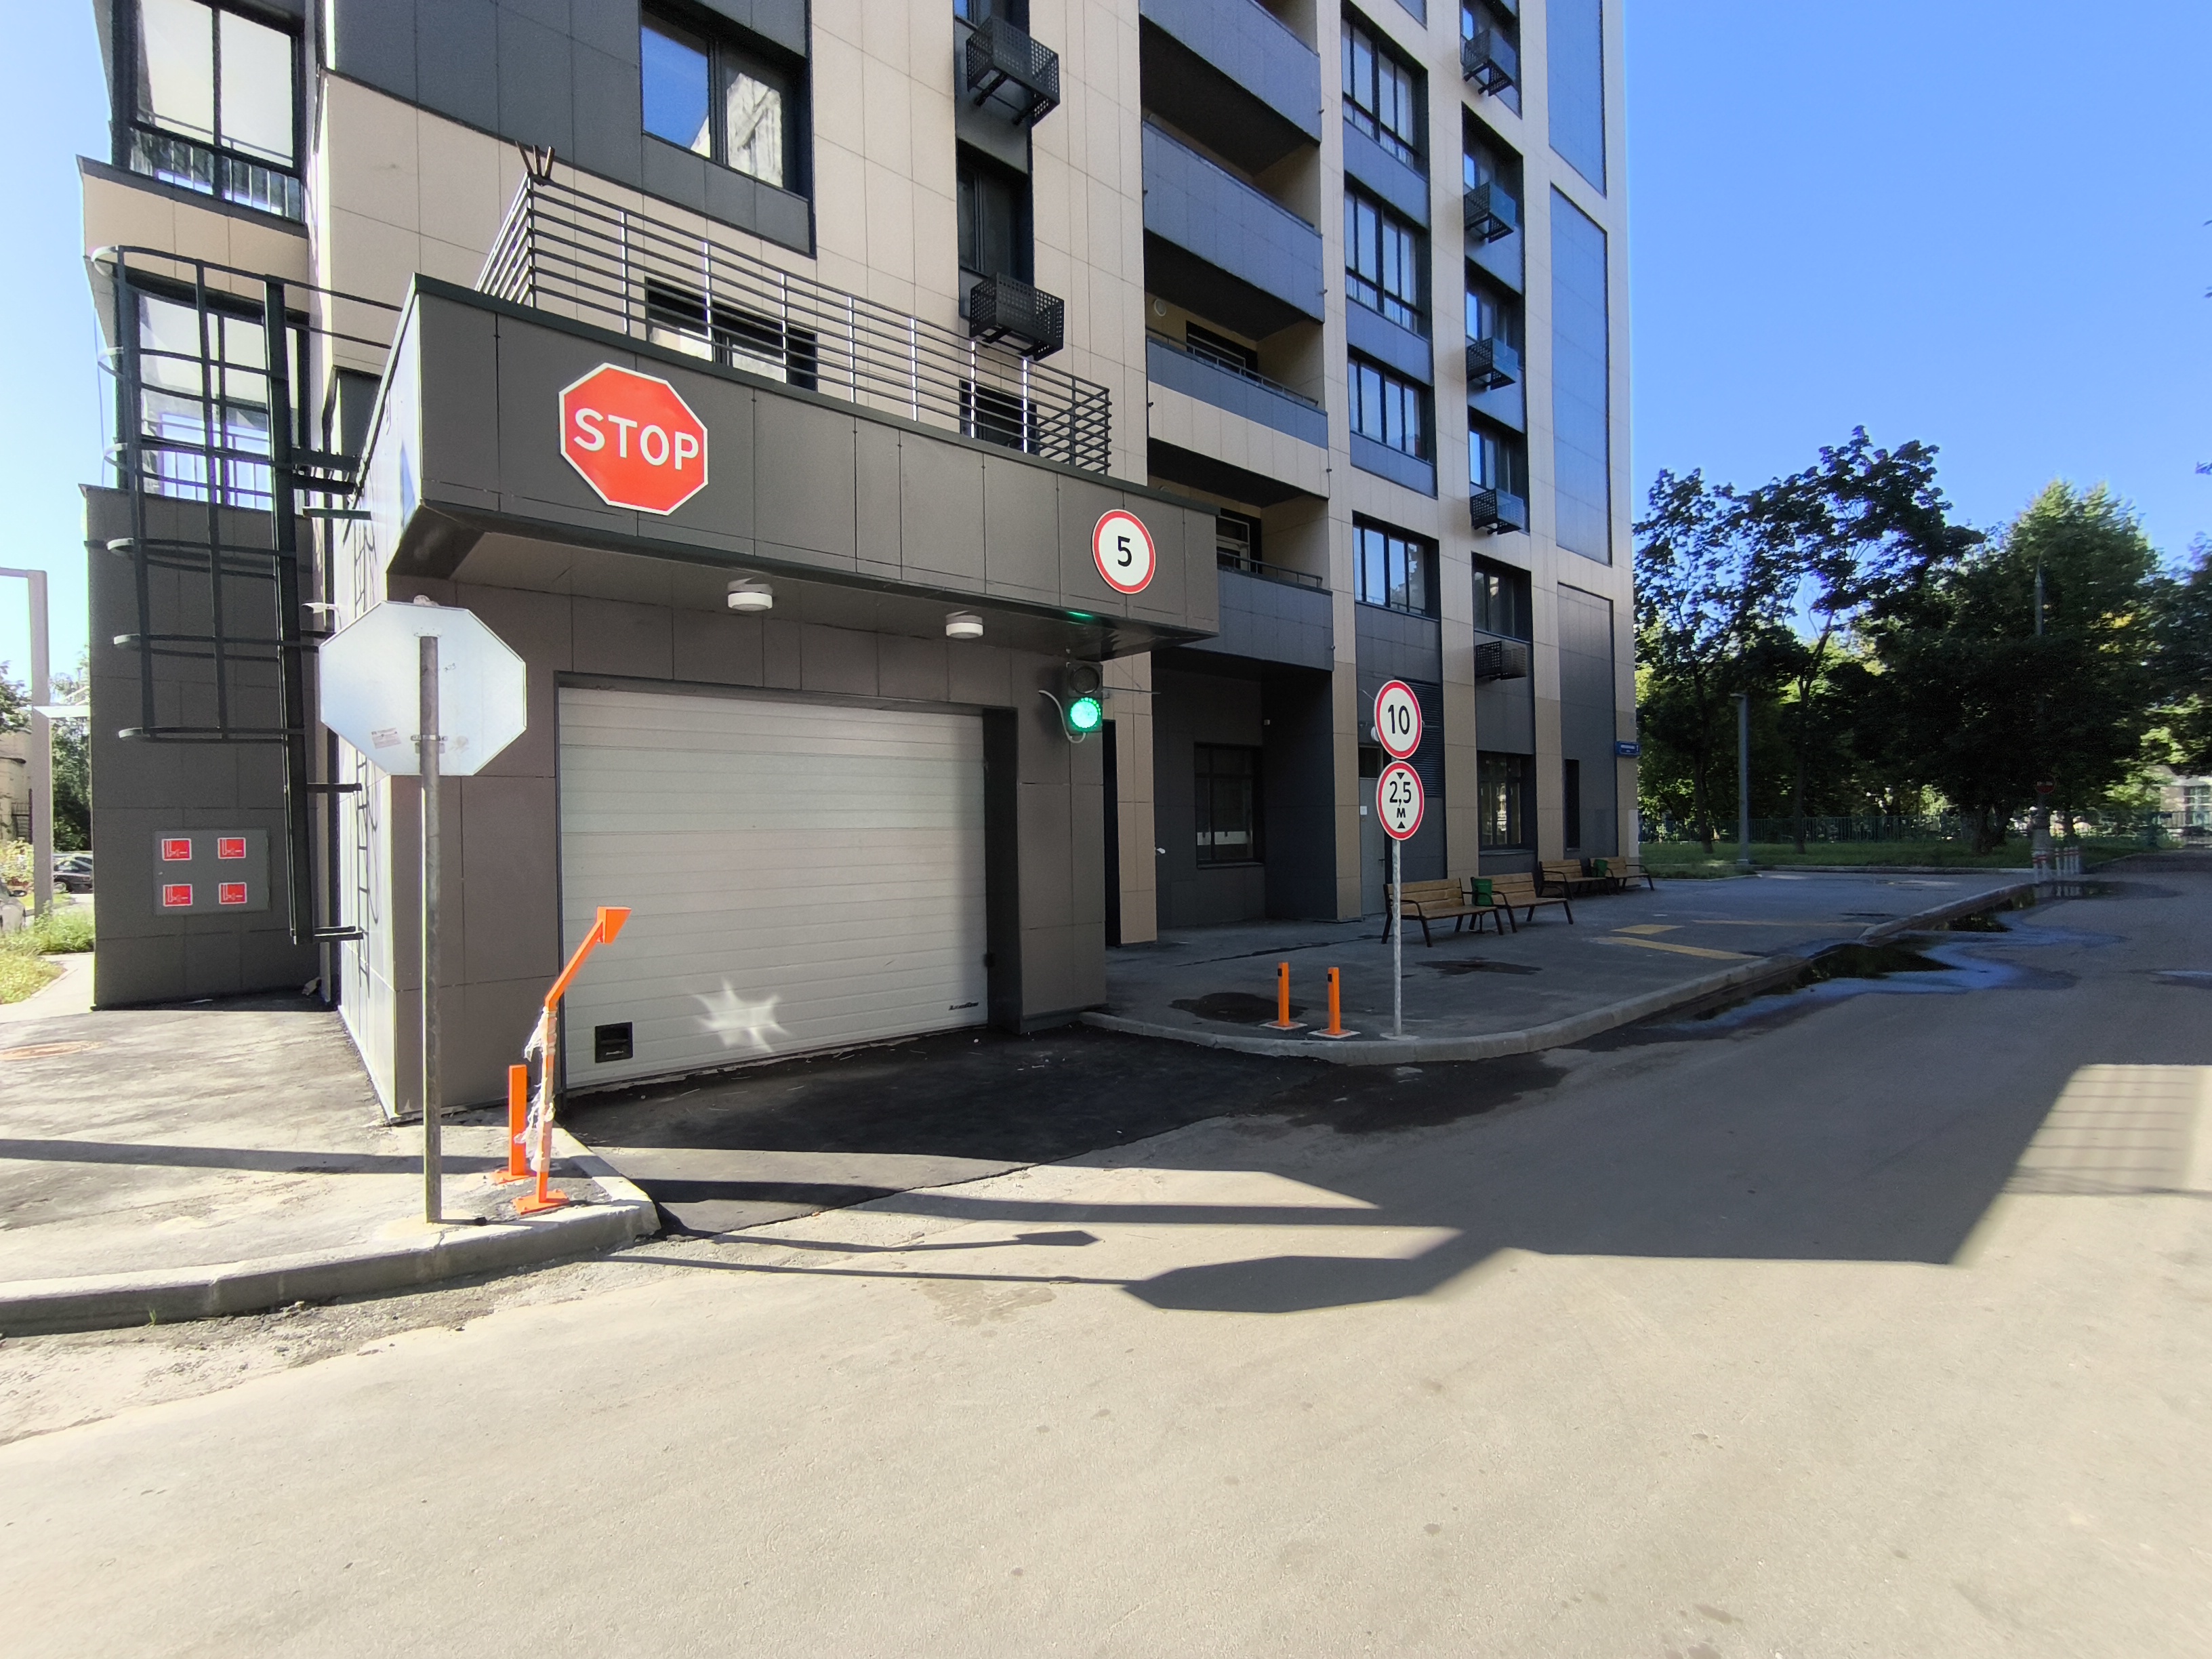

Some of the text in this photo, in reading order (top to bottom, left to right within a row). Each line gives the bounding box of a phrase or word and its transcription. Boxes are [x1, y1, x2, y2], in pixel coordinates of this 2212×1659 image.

[573, 407, 699, 470] STOP
[1117, 535, 1132, 567] 5
[1387, 704, 1410, 735] 10
[1389, 781, 1412, 807] 2,5
